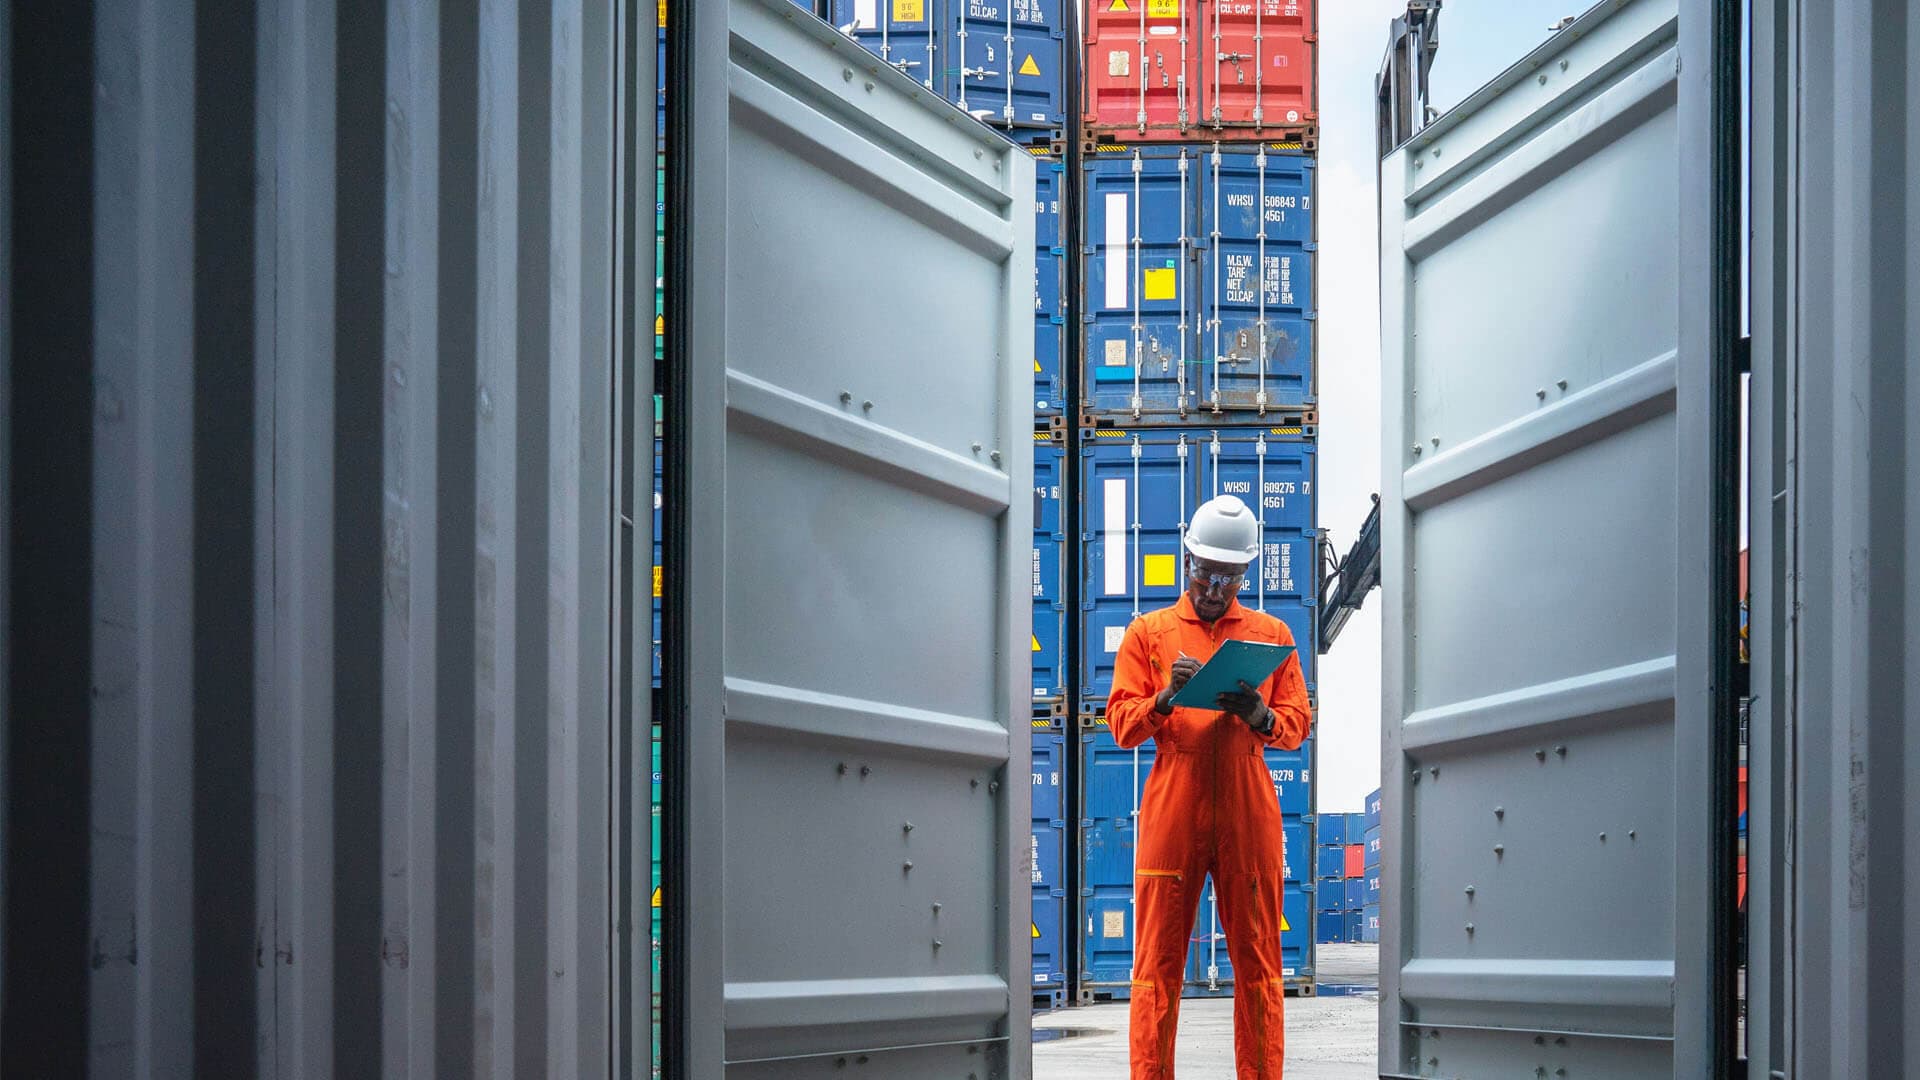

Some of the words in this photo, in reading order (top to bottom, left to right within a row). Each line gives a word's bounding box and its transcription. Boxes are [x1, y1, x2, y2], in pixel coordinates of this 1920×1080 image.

[1227, 194, 1254, 206] WHSU
[1264, 195, 1296, 208] 506843
[1264, 210, 1285, 222] 45G1
[1226, 254, 1253, 267] M.G.W.
[1227, 266, 1246, 279] TARE
[1226, 278, 1242, 290] NET
[1223, 481, 1250, 493] WHSU
[1263, 482, 1295, 494] 609275
[1263, 496, 1285, 509] 45G1
